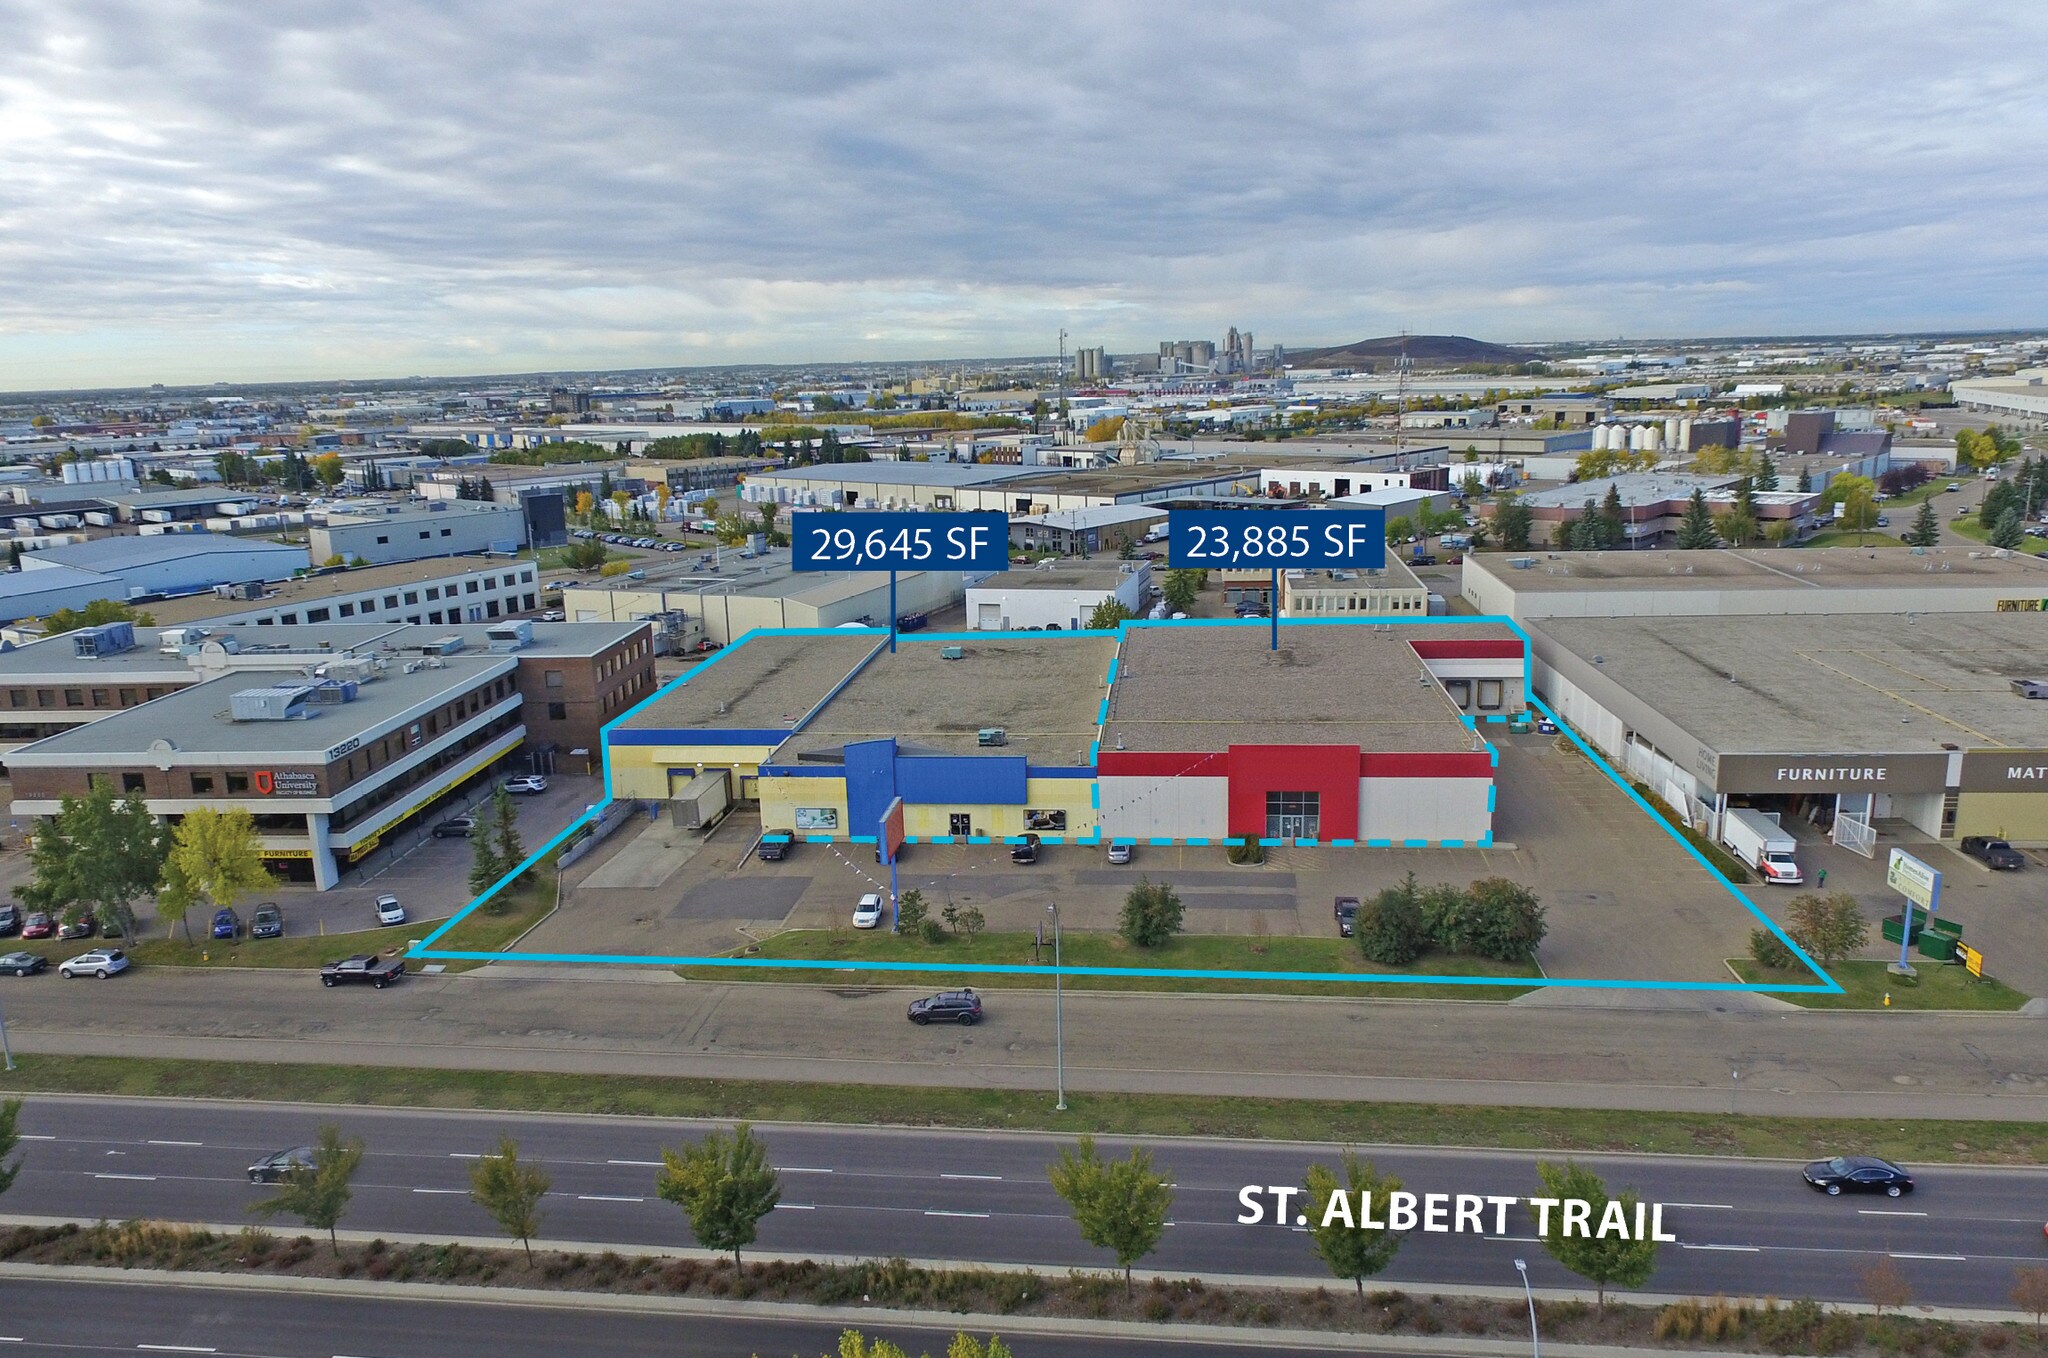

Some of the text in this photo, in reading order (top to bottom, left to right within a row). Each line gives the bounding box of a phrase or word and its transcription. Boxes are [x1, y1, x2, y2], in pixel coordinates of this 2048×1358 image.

[1997, 599, 2040, 612] FURNITURE
[328, 738, 360, 760] 13220
[274, 772, 316, 780] Athabasca
[1777, 768, 1887, 781] FURNITURE
[2007, 767, 2048, 779] MAT
[274, 781, 318, 790] University
